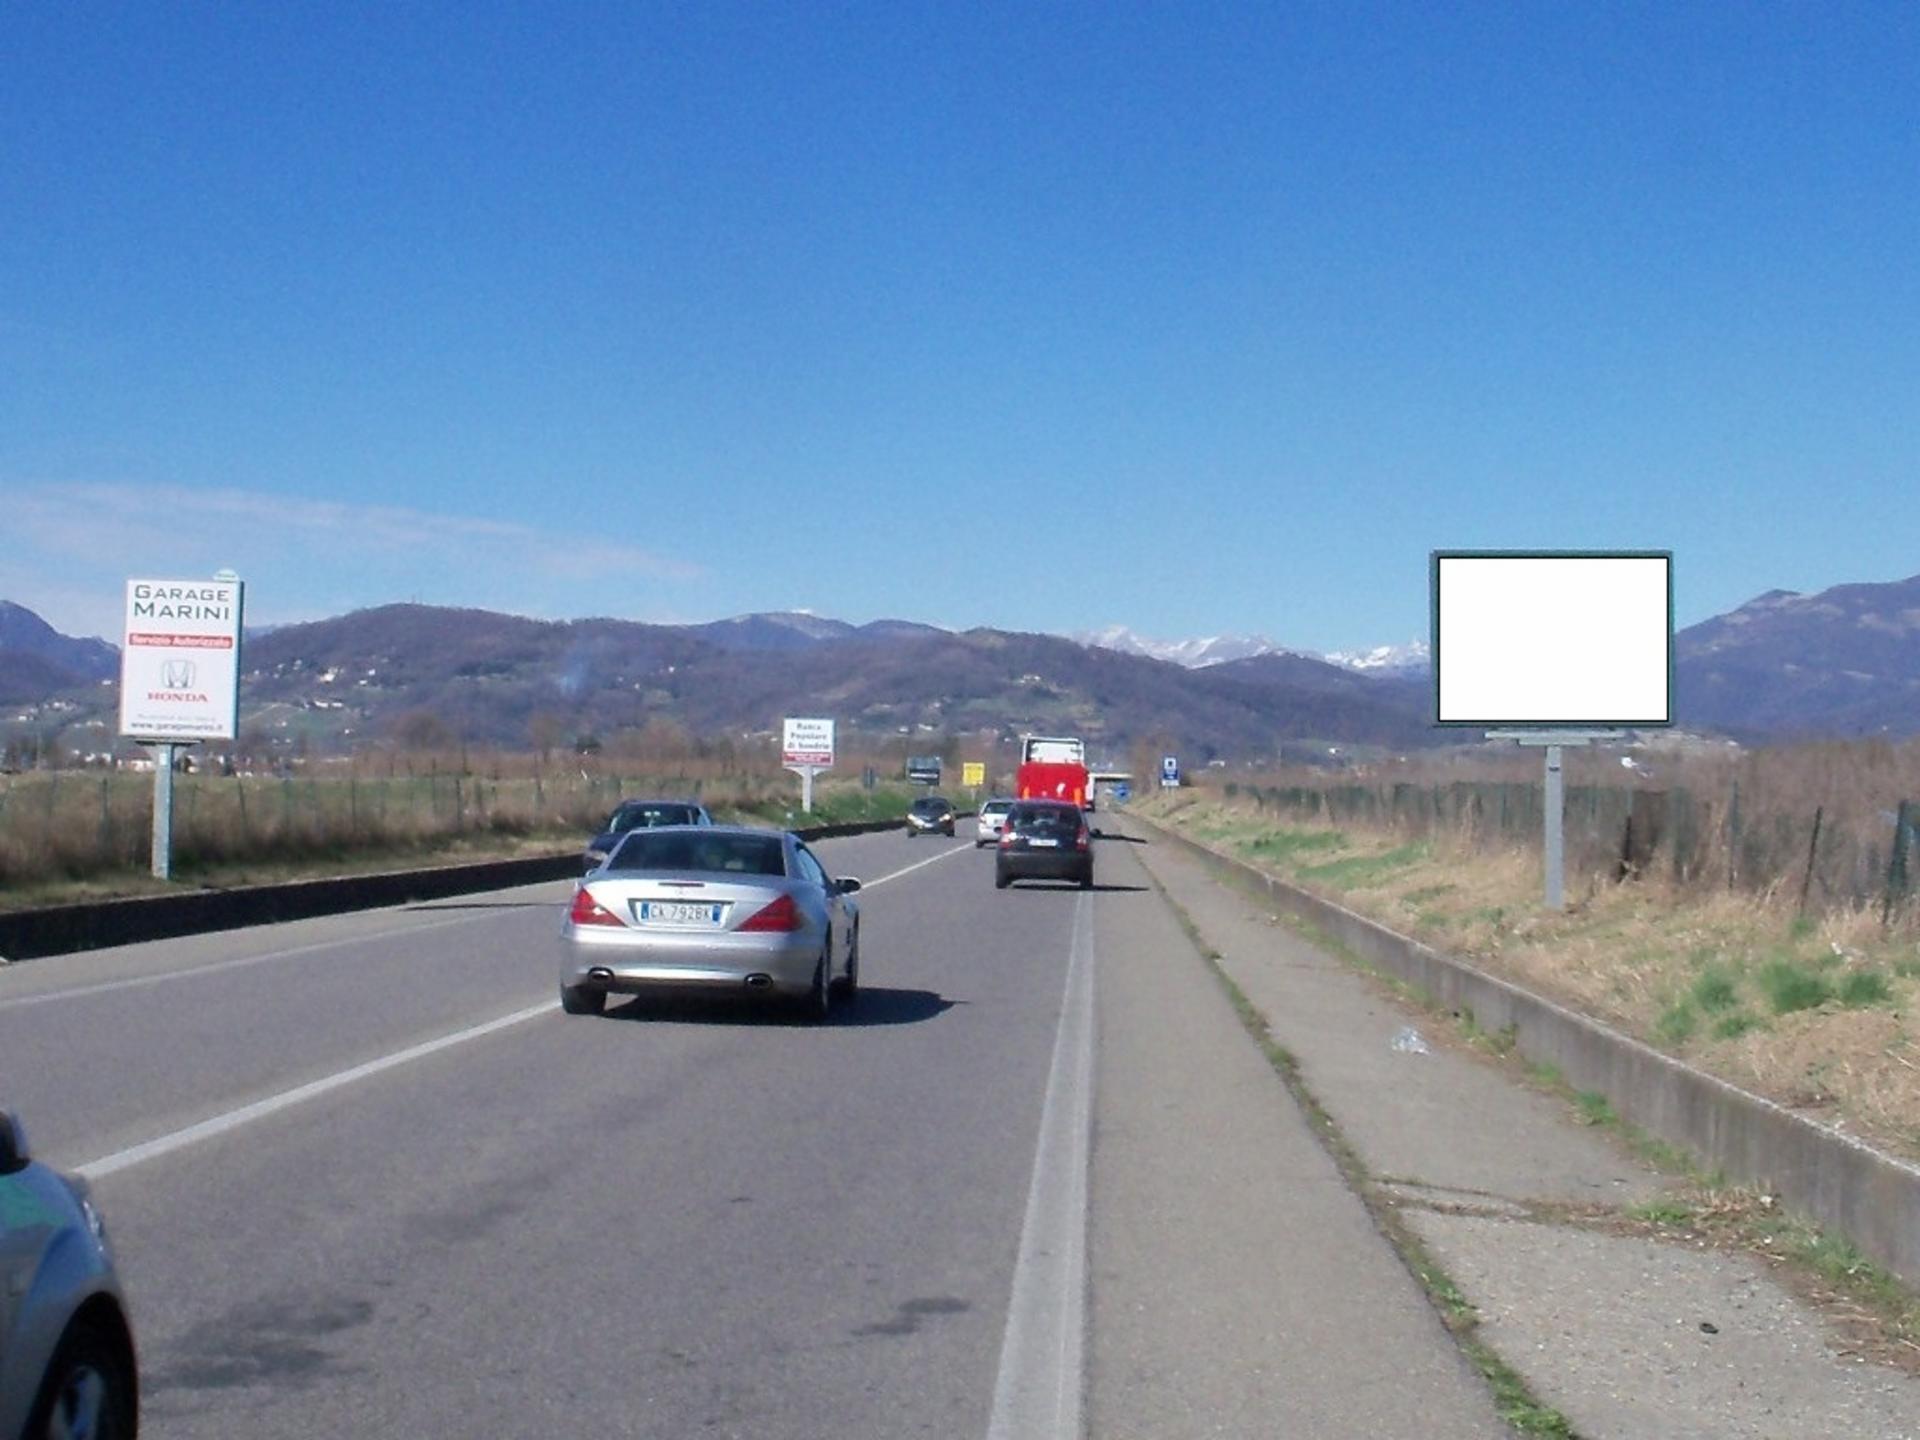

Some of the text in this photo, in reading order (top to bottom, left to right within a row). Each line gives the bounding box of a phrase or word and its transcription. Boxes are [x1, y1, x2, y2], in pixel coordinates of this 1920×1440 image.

[135, 584, 229, 602] GARAGE
[134, 602, 229, 620] MARINI
[147, 692, 208, 702] HONDA
